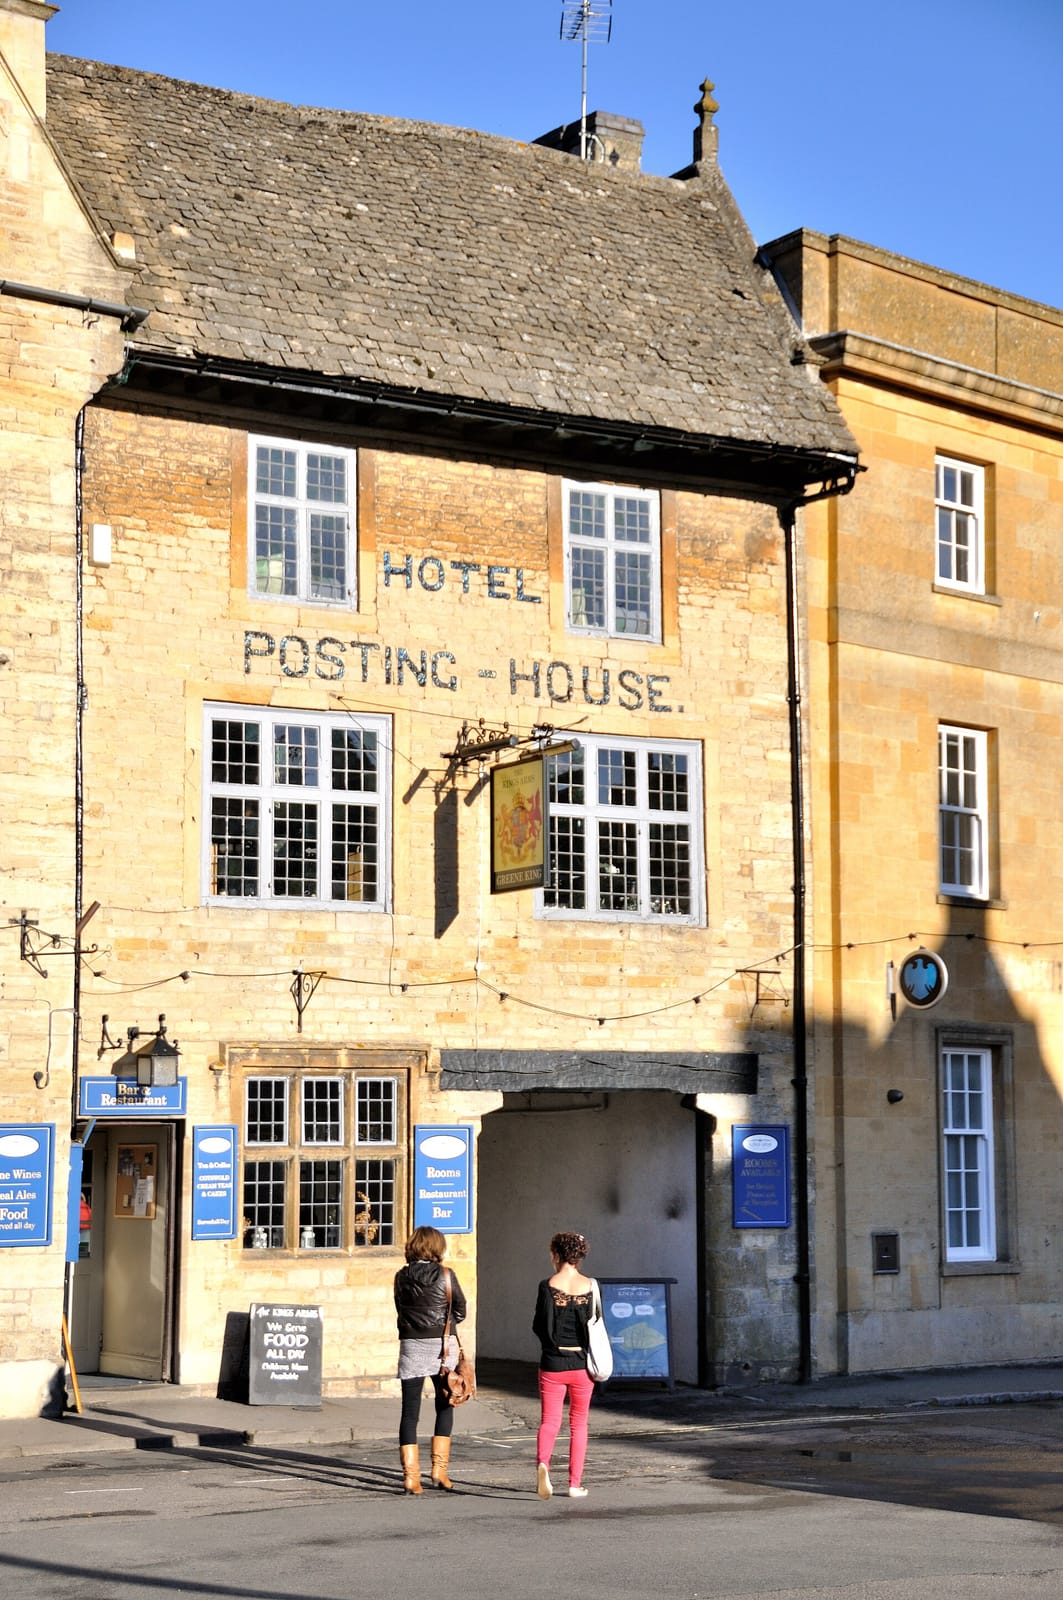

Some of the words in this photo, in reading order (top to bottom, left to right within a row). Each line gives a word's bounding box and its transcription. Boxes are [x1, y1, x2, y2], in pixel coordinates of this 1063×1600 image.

[383, 551, 542, 603] HOTEL
[244, 630, 458, 692] POSTING
[496, 871, 524, 886] GREENE
[524, 868, 542, 881] KING
[117, 1083, 140, 1096] Bar
[101, 1093, 168, 1106] Restaurant
[0, 1171, 11, 1180] ne
[12, 1168, 42, 1180] Wines
[426, 1166, 461, 1178] Rooms
[0, 1189, 14, 1200] eal
[15, 1189, 37, 1200] Ales
[419, 1188, 467, 1199] Restaurant
[0, 1207, 28, 1220] Food
[432, 1207, 453, 1218] Bar
[14, 1221, 23, 1230] all
[23, 1221, 35, 1231] day
[266, 1321, 282, 1331] We
[263, 1333, 309, 1348] FOOD
[266, 1348, 286, 1359] ALL
[287, 1349, 306, 1360] DAY
